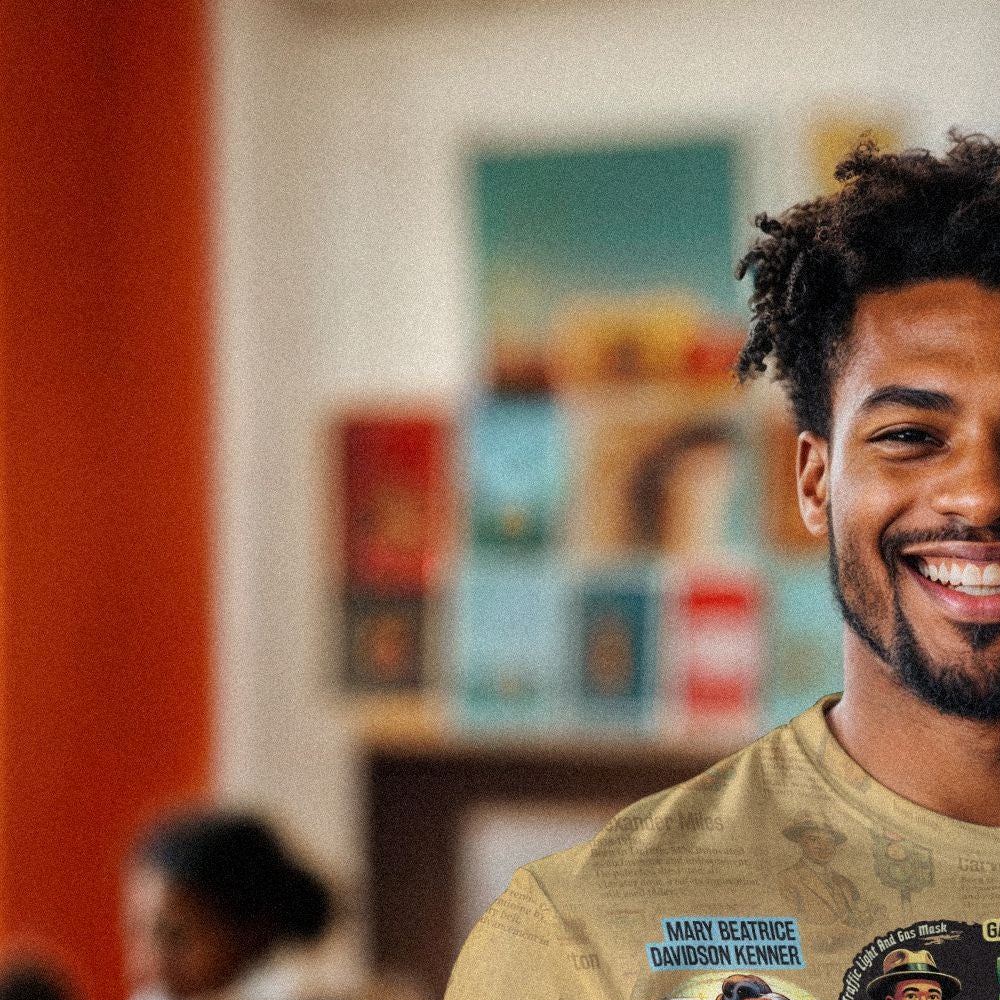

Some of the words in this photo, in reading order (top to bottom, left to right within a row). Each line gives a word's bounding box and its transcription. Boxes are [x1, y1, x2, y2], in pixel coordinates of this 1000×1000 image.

[666, 921, 713, 942] MARY
[718, 920, 796, 942] BEATRICE
[651, 944, 733, 967] DAVIDSON
[735, 945, 802, 966] KENNER
[858, 945, 877, 973] Light
[877, 936, 896, 952] And
[897, 929, 916, 942] Gas
[919, 922, 947, 936] Mask
